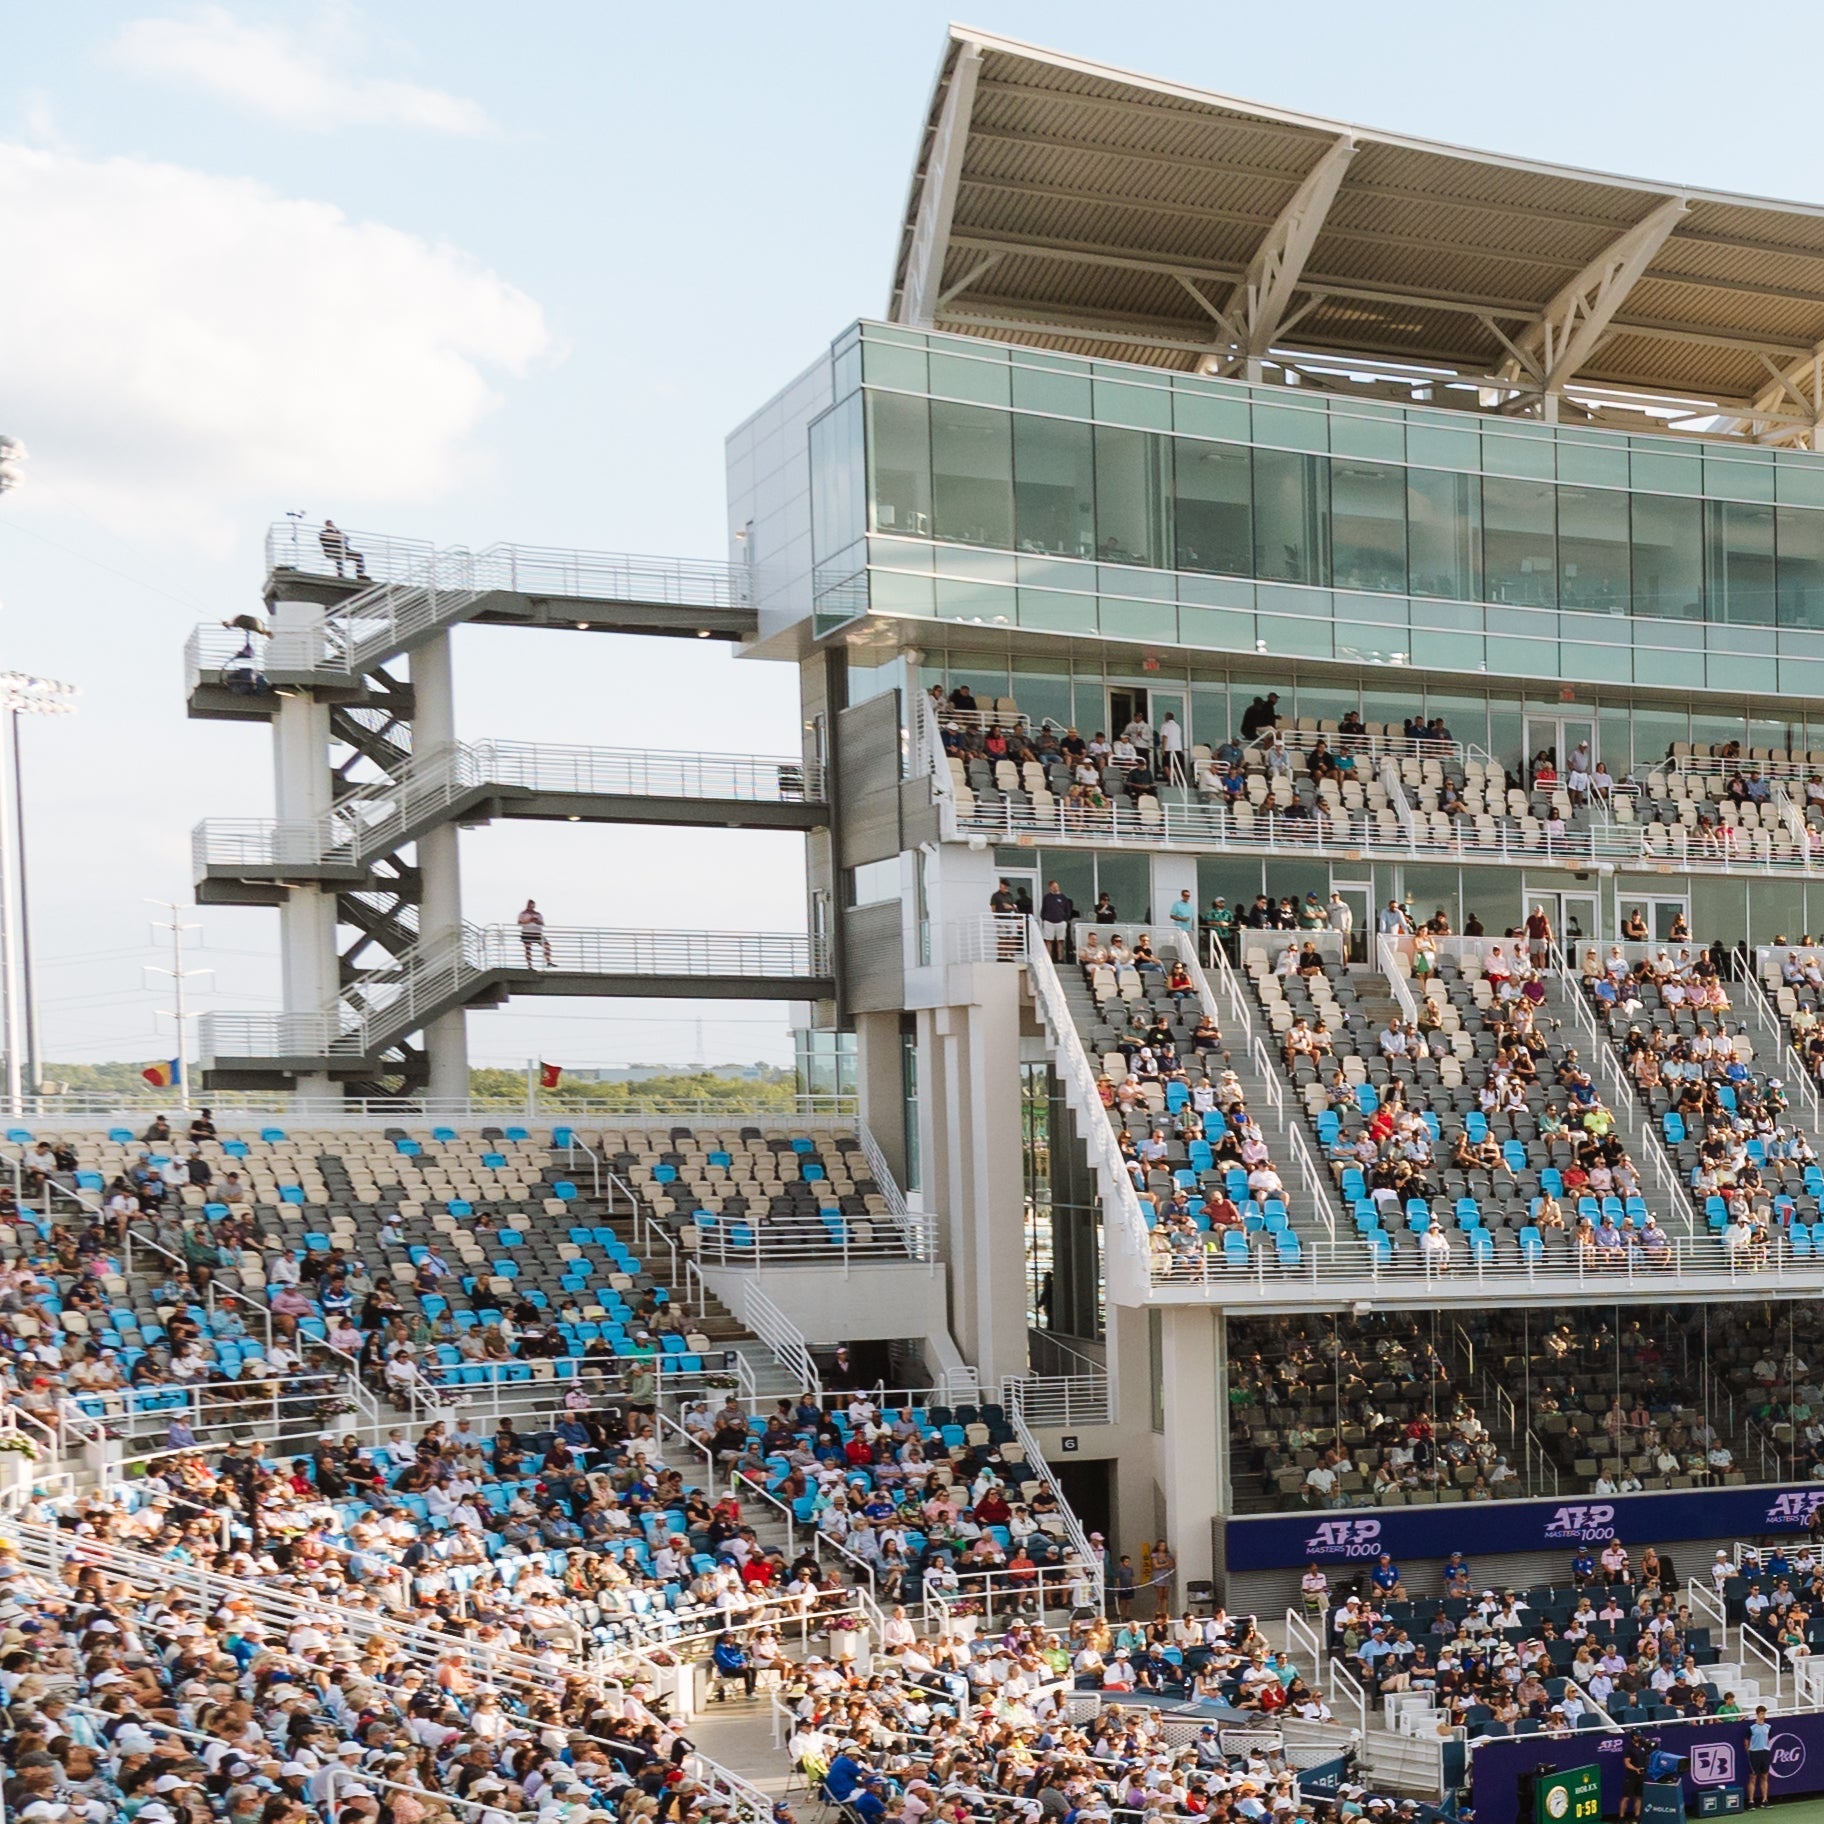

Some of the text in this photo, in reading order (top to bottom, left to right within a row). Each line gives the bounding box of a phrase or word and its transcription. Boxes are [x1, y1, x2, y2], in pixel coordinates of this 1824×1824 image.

[1543, 1505, 1615, 1531] ATP
[1765, 1513, 1800, 1524] MASTERS
[1304, 1520, 1381, 1546] ATP
[1544, 1527, 1615, 1541] MASTERS 1000
[1305, 1543, 1381, 1557] MASTERS 1000
[1598, 1739, 1623, 1749] ATP
[1772, 1747, 1802, 1764] P&G
[1697, 1750, 1730, 1777] 5/3
[1574, 1783, 1599, 1795] ROLEX
[1576, 1799, 1598, 1818] 0:58
